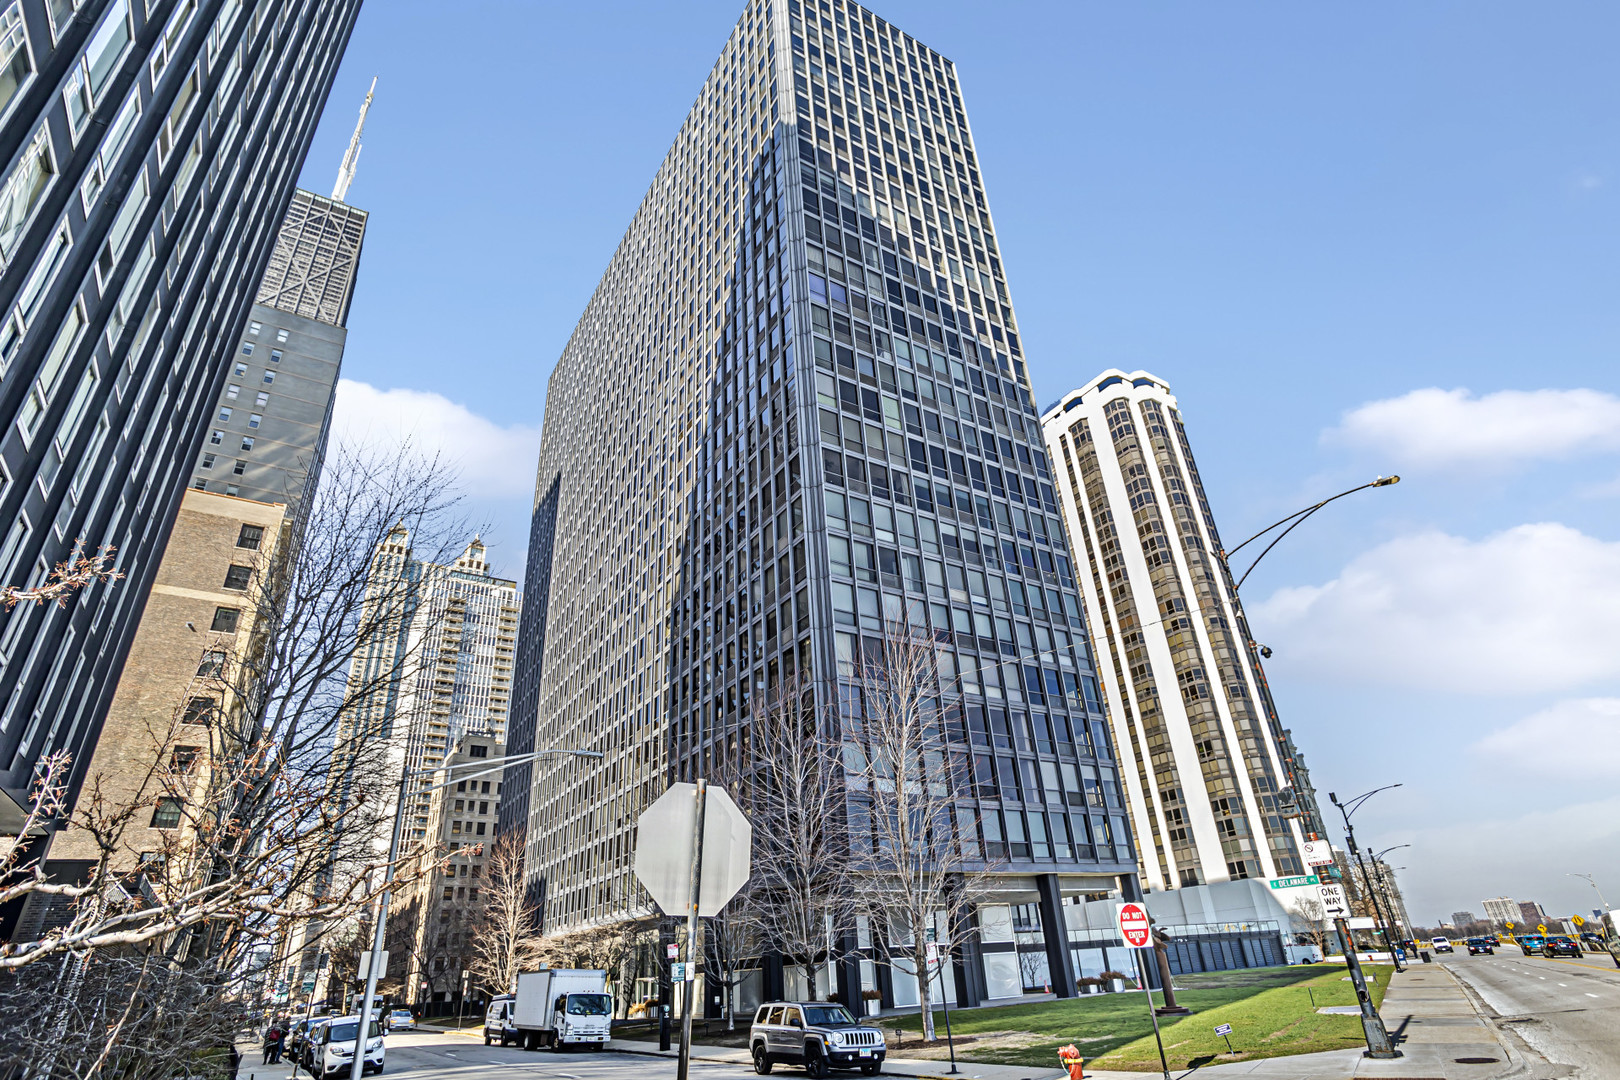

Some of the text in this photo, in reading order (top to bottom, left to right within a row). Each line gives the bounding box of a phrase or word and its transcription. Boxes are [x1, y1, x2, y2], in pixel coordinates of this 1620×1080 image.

[1278, 877, 1309, 887] DELAWARE
[1321, 887, 1339, 896] ONE
[1323, 897, 1341, 905] WAY
[1122, 912, 1130, 920] DO
[1128, 931, 1145, 939] ENTER
